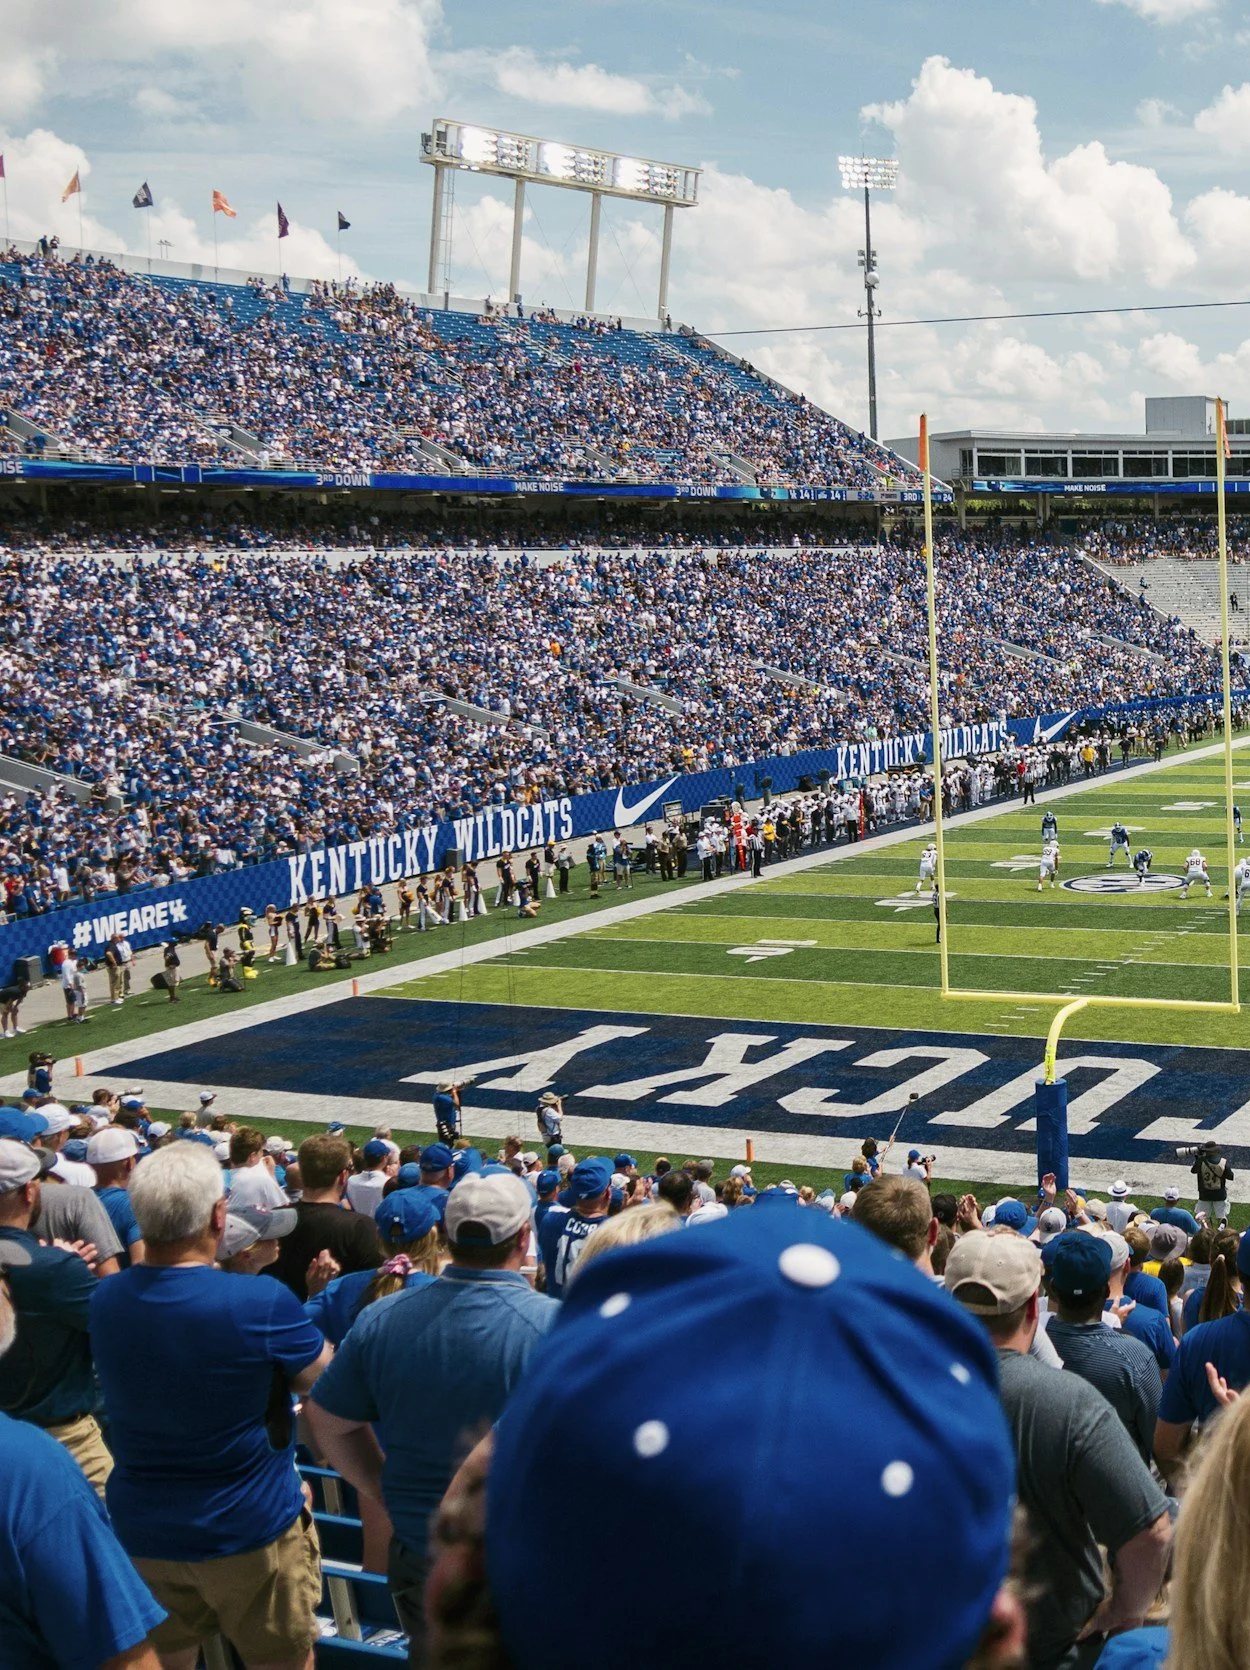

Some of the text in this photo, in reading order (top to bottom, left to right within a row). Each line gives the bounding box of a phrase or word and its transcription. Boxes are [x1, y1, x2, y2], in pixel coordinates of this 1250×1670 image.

[316, 474, 370, 486] 3RD DOWN
[515, 482, 564, 492] MAKE NOISE
[691, 486, 717, 496] DOWN
[800, 490, 810, 500] 14
[830, 490, 840, 500] 14
[857, 492, 874, 500] 5:24
[903, 493, 917, 501] 3RD
[943, 492, 952, 501] 24
[836, 733, 925, 780] KENTUCKY
[288, 797, 574, 907] KENTUCKY WILDCATS
[1190, 858, 1201, 866] 68
[1244, 869, 1250, 878] 6
